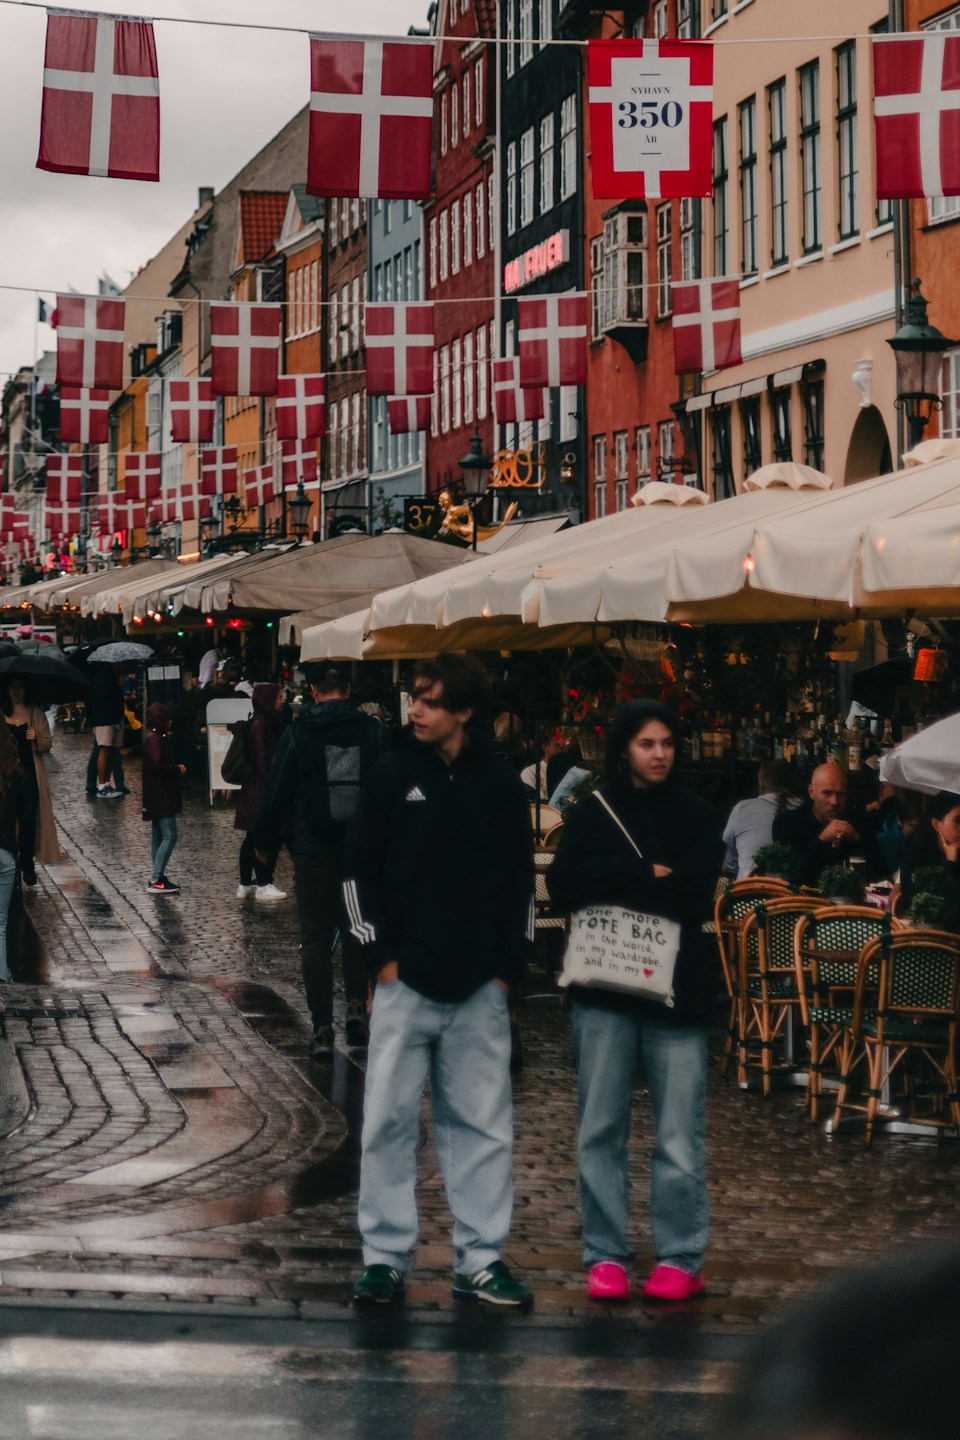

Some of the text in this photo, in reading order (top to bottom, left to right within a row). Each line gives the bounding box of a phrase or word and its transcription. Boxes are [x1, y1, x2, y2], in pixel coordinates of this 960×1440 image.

[630, 86, 671, 95] NYHAVN
[618, 101, 683, 129] 350
[644, 134, 658, 144] ÅR
[408, 505, 436, 530] 37
[586, 907, 660, 928] one more
[585, 931, 596, 941] in
[601, 933, 618, 946] the
[632, 923, 668, 946] BAG
[576, 943, 586, 953] in
[591, 946, 607, 958] my
[584, 957, 640, 977] and in my
